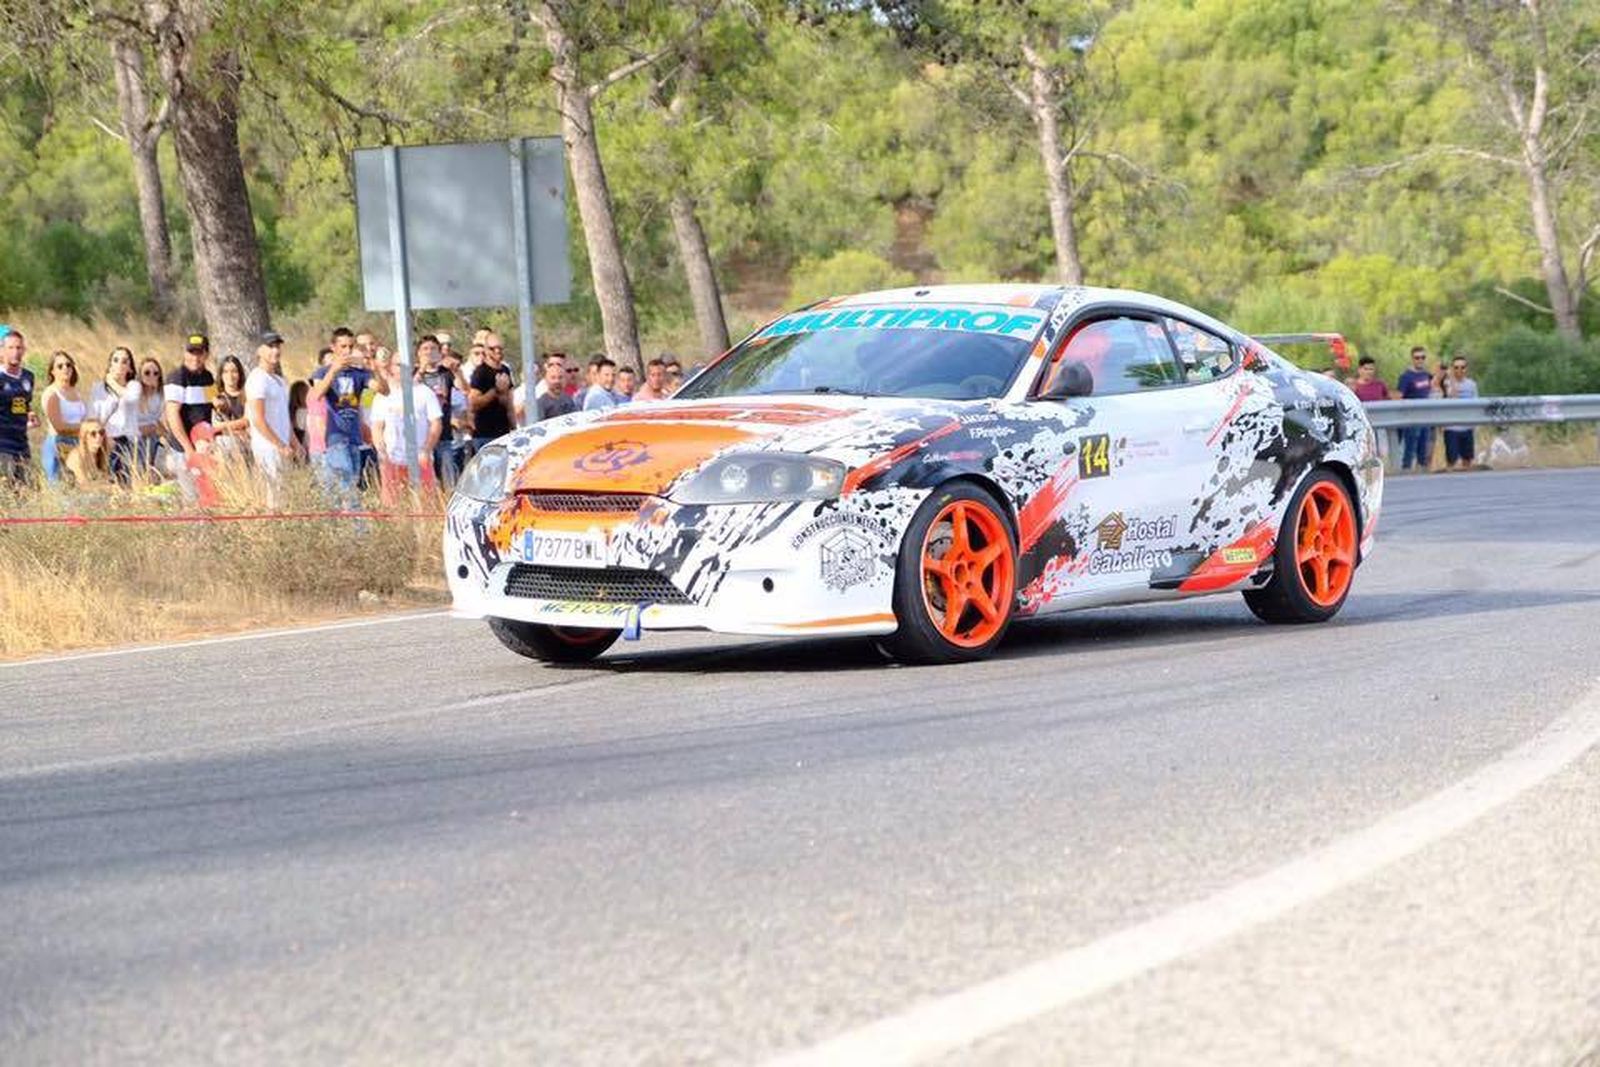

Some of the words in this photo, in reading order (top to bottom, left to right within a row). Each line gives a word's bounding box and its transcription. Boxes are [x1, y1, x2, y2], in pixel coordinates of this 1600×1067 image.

[759, 308, 1042, 337] MULTIPROF
[1081, 436, 1108, 475] 14
[1126, 514, 1178, 541] Hostal
[1088, 545, 1173, 574] Caballero
